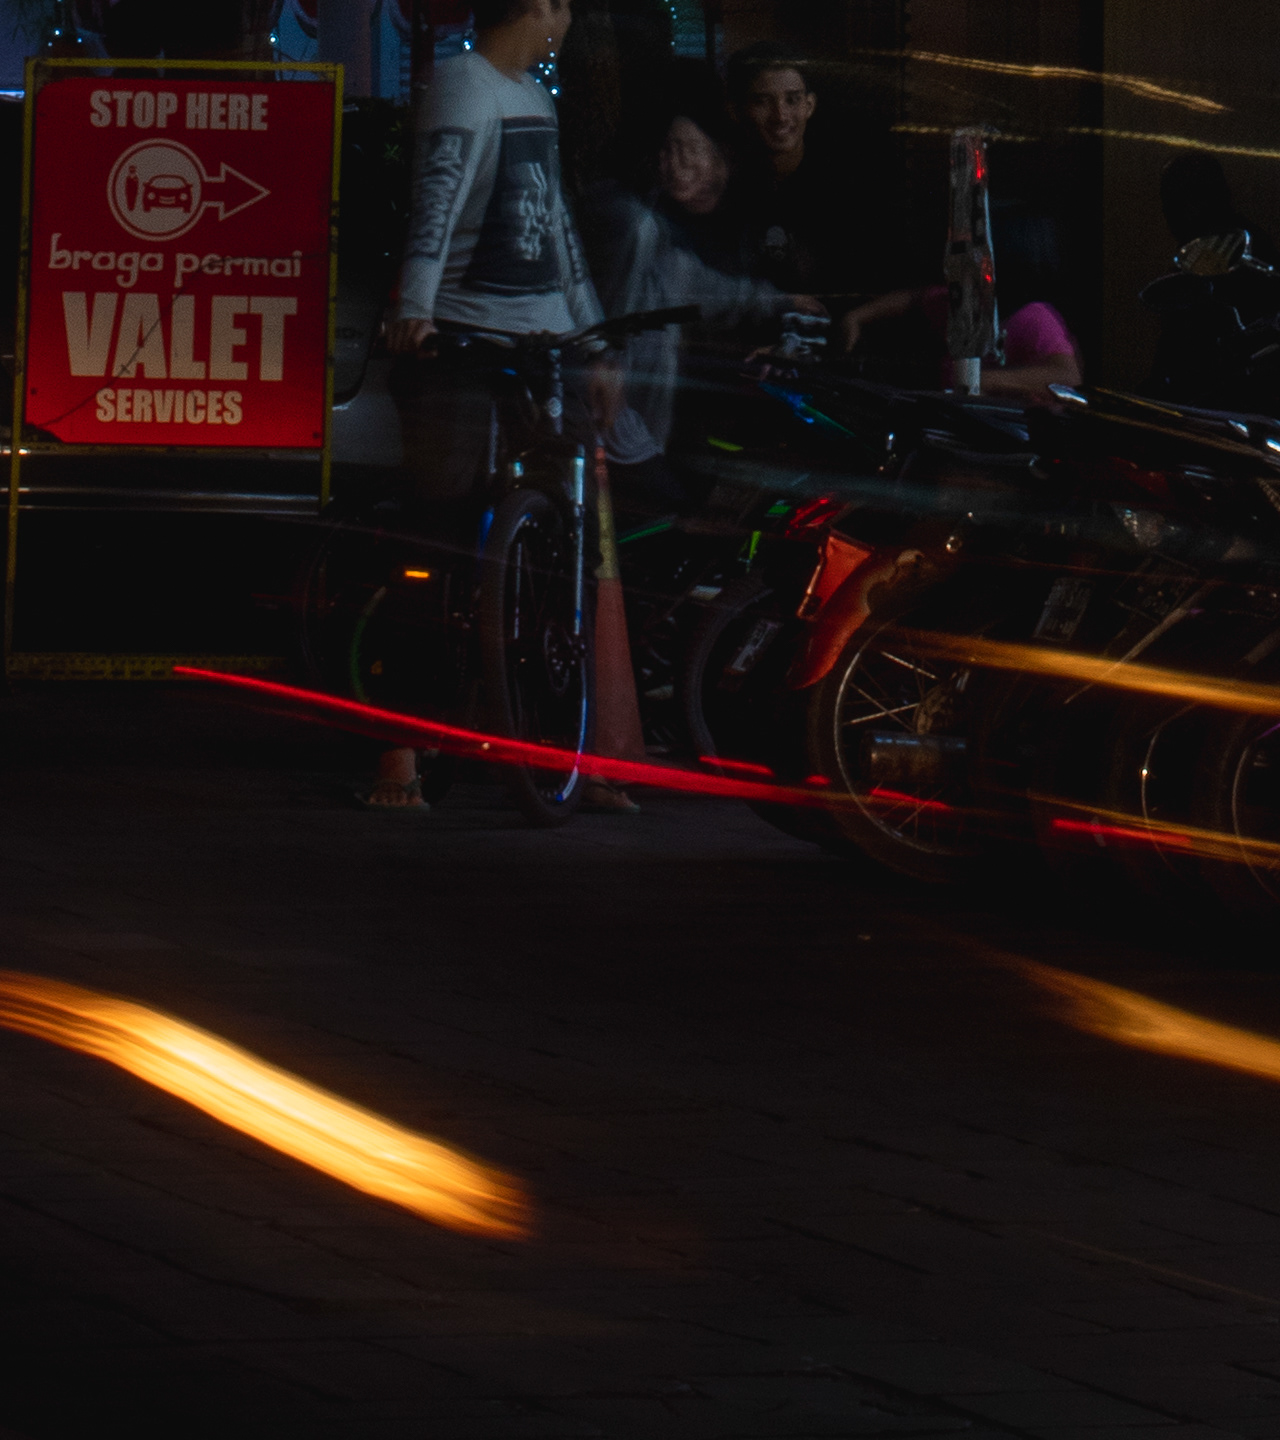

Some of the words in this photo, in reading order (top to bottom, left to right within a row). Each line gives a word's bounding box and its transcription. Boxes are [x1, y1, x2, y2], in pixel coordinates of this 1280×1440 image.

[90, 89, 179, 128] STOP
[185, 92, 269, 131] HERE
[48, 232, 164, 288] braga
[174, 249, 303, 288] permai
[62, 291, 298, 381] VALET
[95, 388, 244, 425] SERVICES
